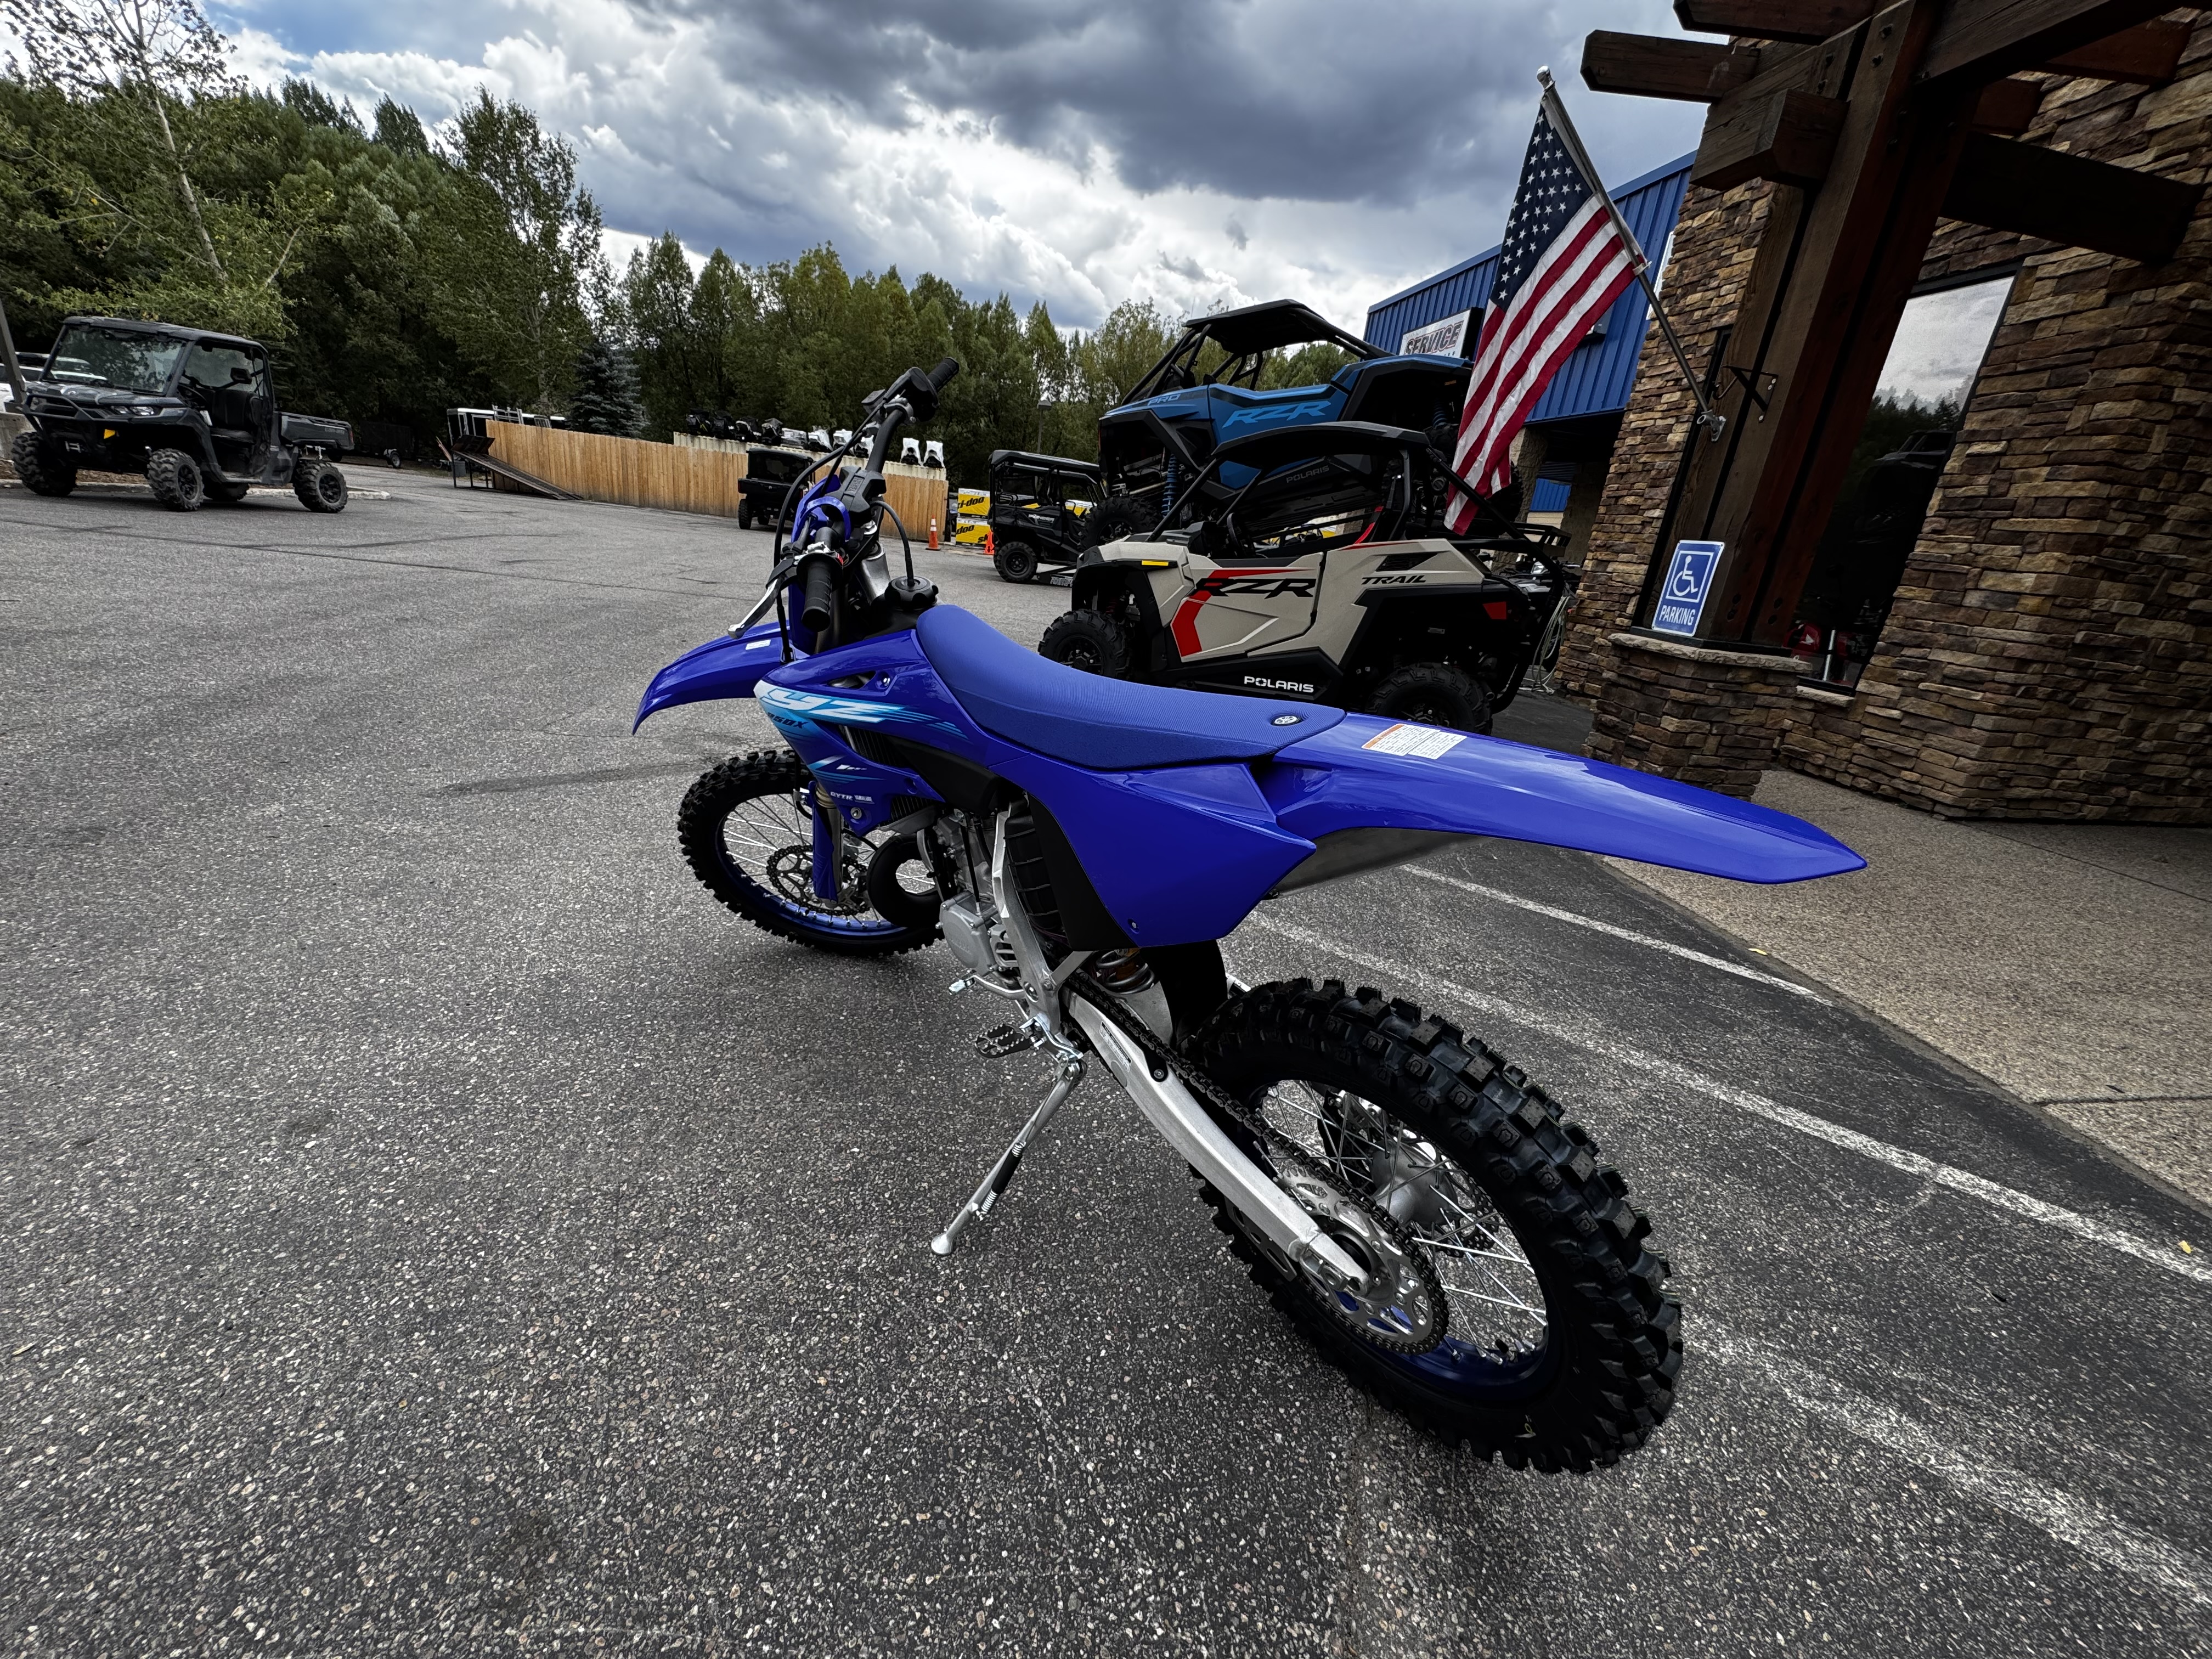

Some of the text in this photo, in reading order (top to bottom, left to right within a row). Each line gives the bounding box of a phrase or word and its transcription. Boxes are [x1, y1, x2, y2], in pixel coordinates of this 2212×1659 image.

[1404, 320, 1464, 356] SERVICE
[1148, 394, 1181, 406] PRO
[1222, 400, 1331, 429] RZR
[1286, 466, 1330, 483] POLARIS
[1187, 578, 1317, 600] RZR
[1361, 575, 1427, 585] TRAIL
[1658, 605, 1696, 626] PARKING
[1244, 675, 1314, 693] POLARIS
